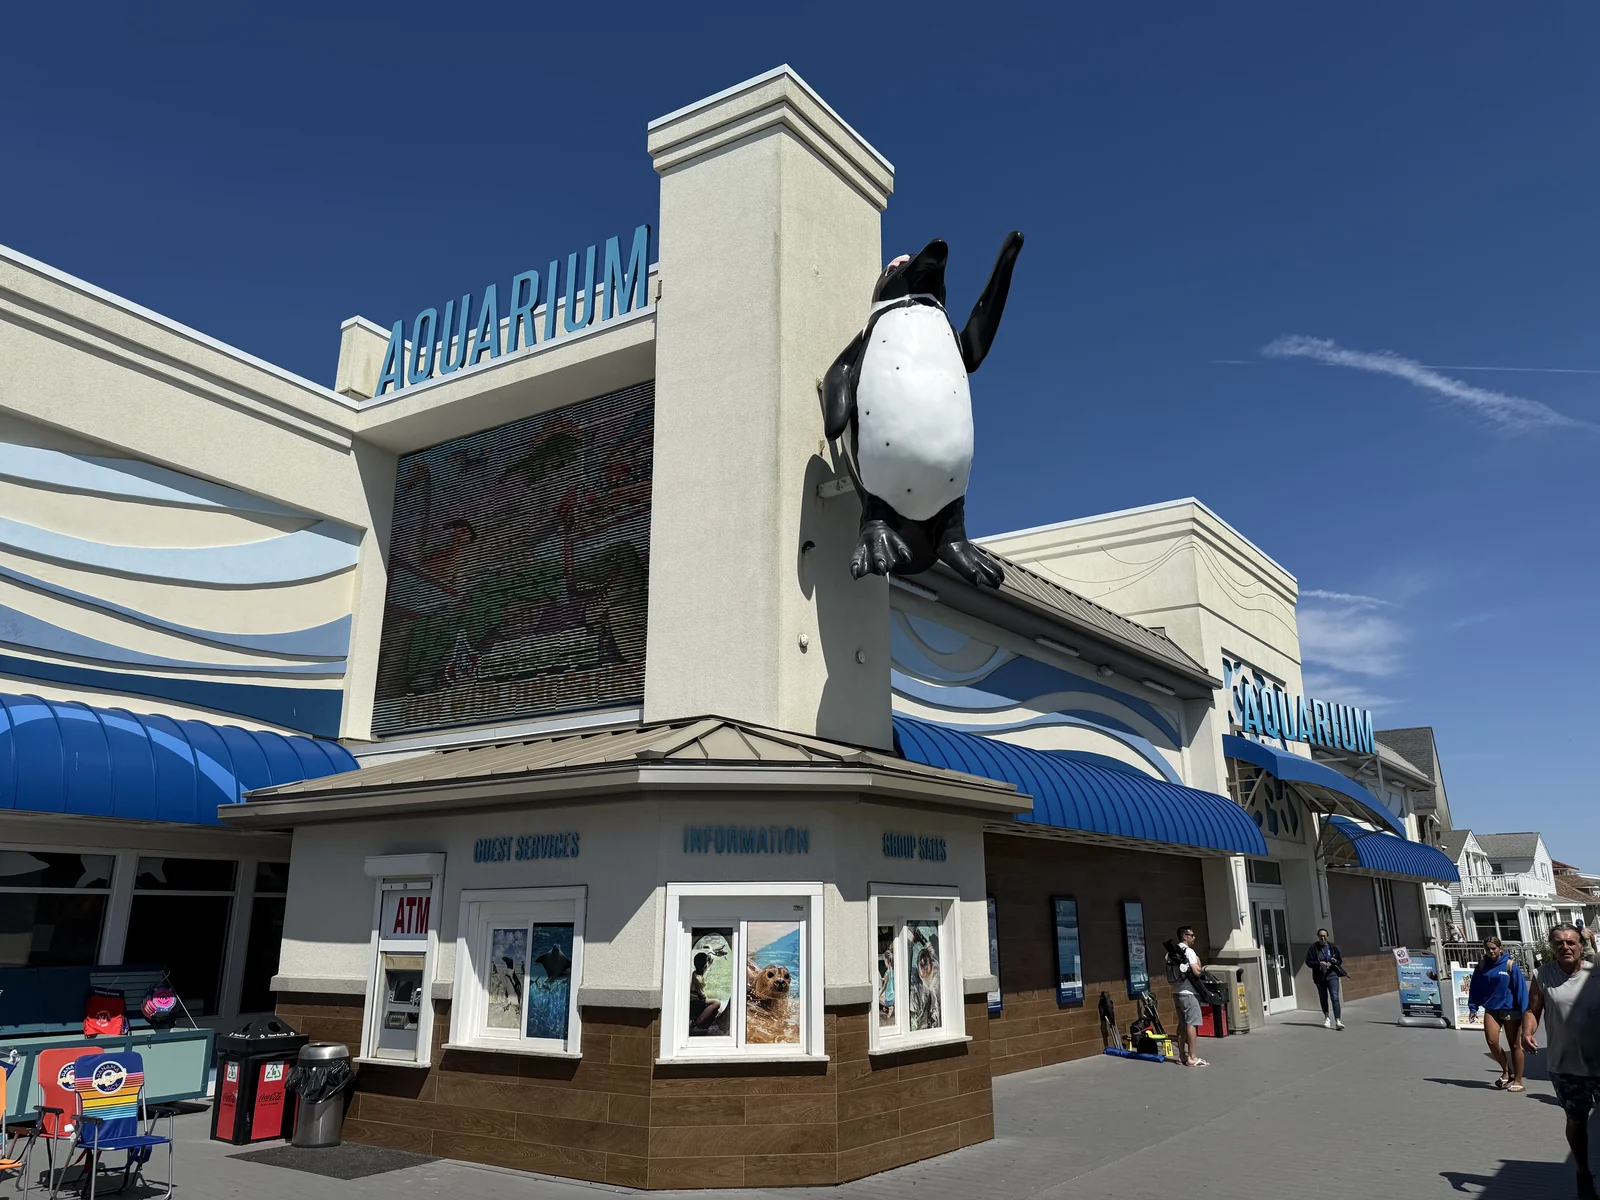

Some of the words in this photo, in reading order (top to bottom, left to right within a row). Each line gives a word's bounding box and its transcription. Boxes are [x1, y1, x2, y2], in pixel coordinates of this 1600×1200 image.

[374, 223, 651, 398] AQUARIUM
[1242, 683, 1376, 754] AQUARIUM
[473, 836, 513, 863] GUEST
[514, 831, 580, 860] SERVICES
[683, 825, 809, 854] INFORMATION
[882, 832, 916, 859] GROUP
[918, 836, 947, 861] SALES
[393, 896, 431, 934] ATM
